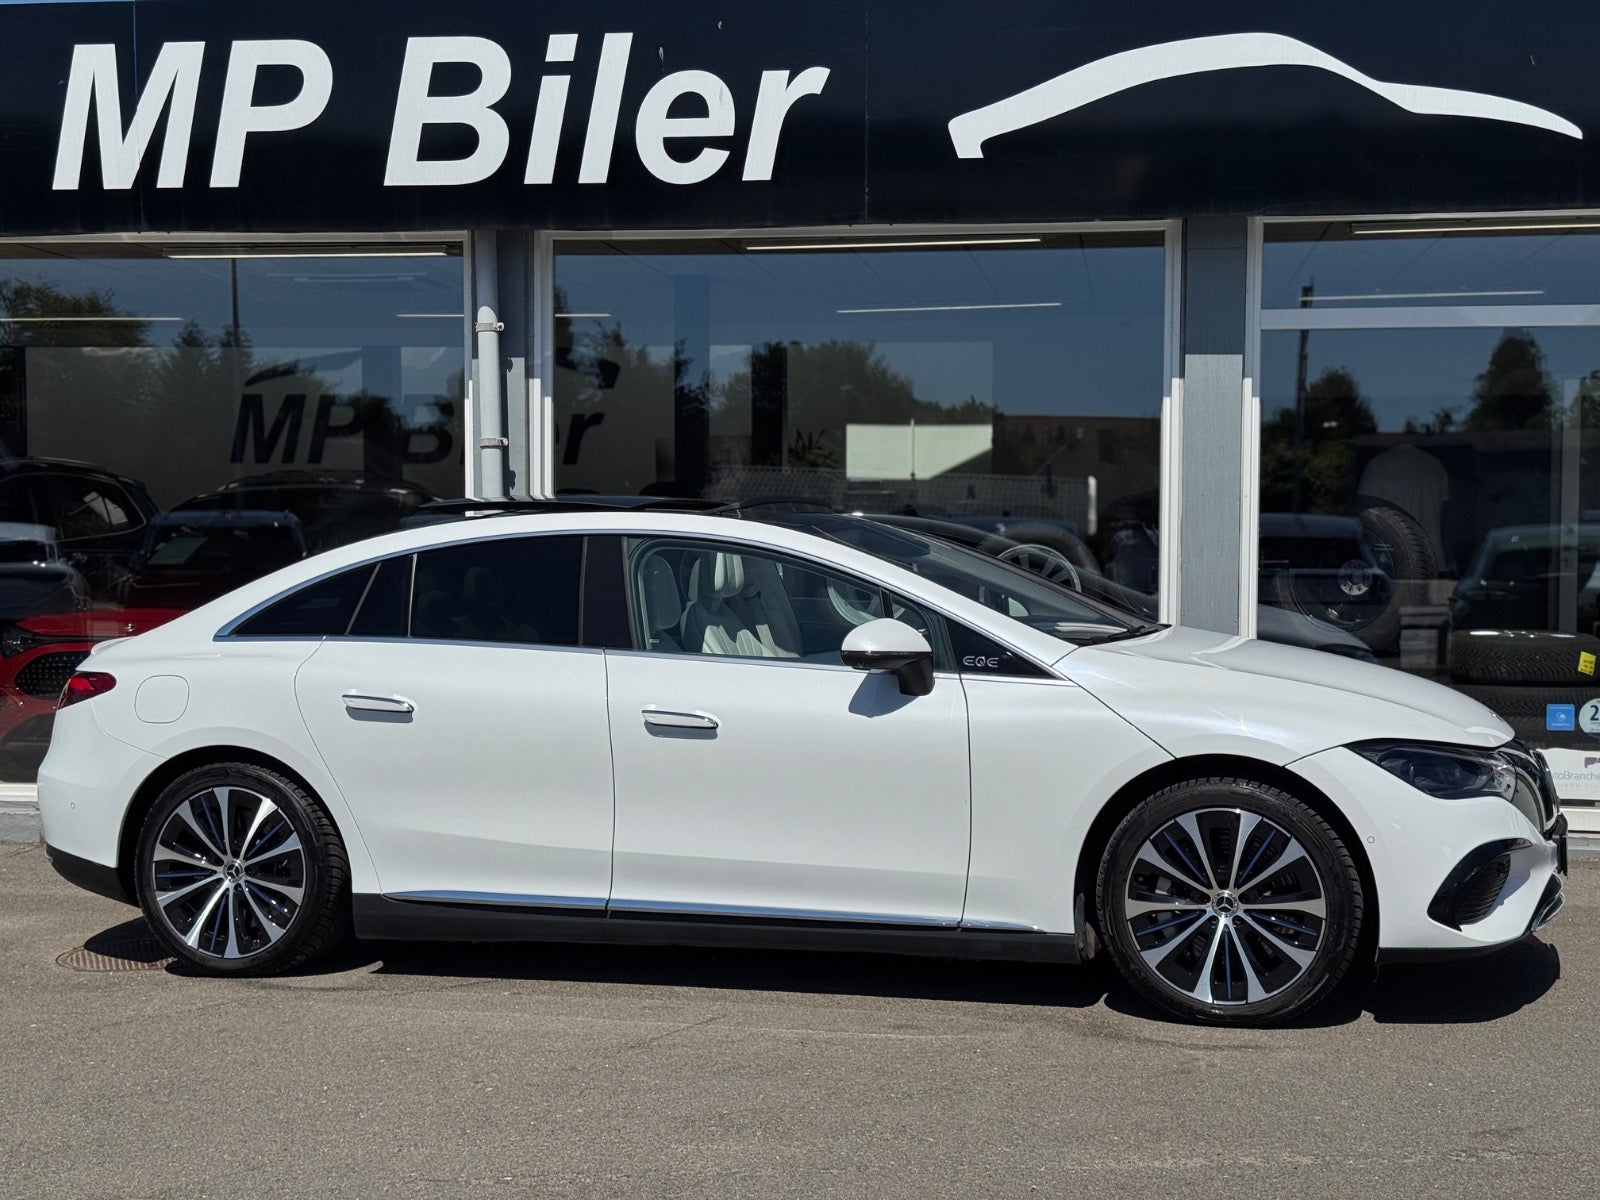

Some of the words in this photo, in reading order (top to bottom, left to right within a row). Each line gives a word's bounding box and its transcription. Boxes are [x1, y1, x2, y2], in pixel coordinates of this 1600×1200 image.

[52, 40, 333, 190] MP
[384, 33, 831, 187] Biler
[231, 393, 365, 465] MP
[963, 656, 999, 667] EQE
